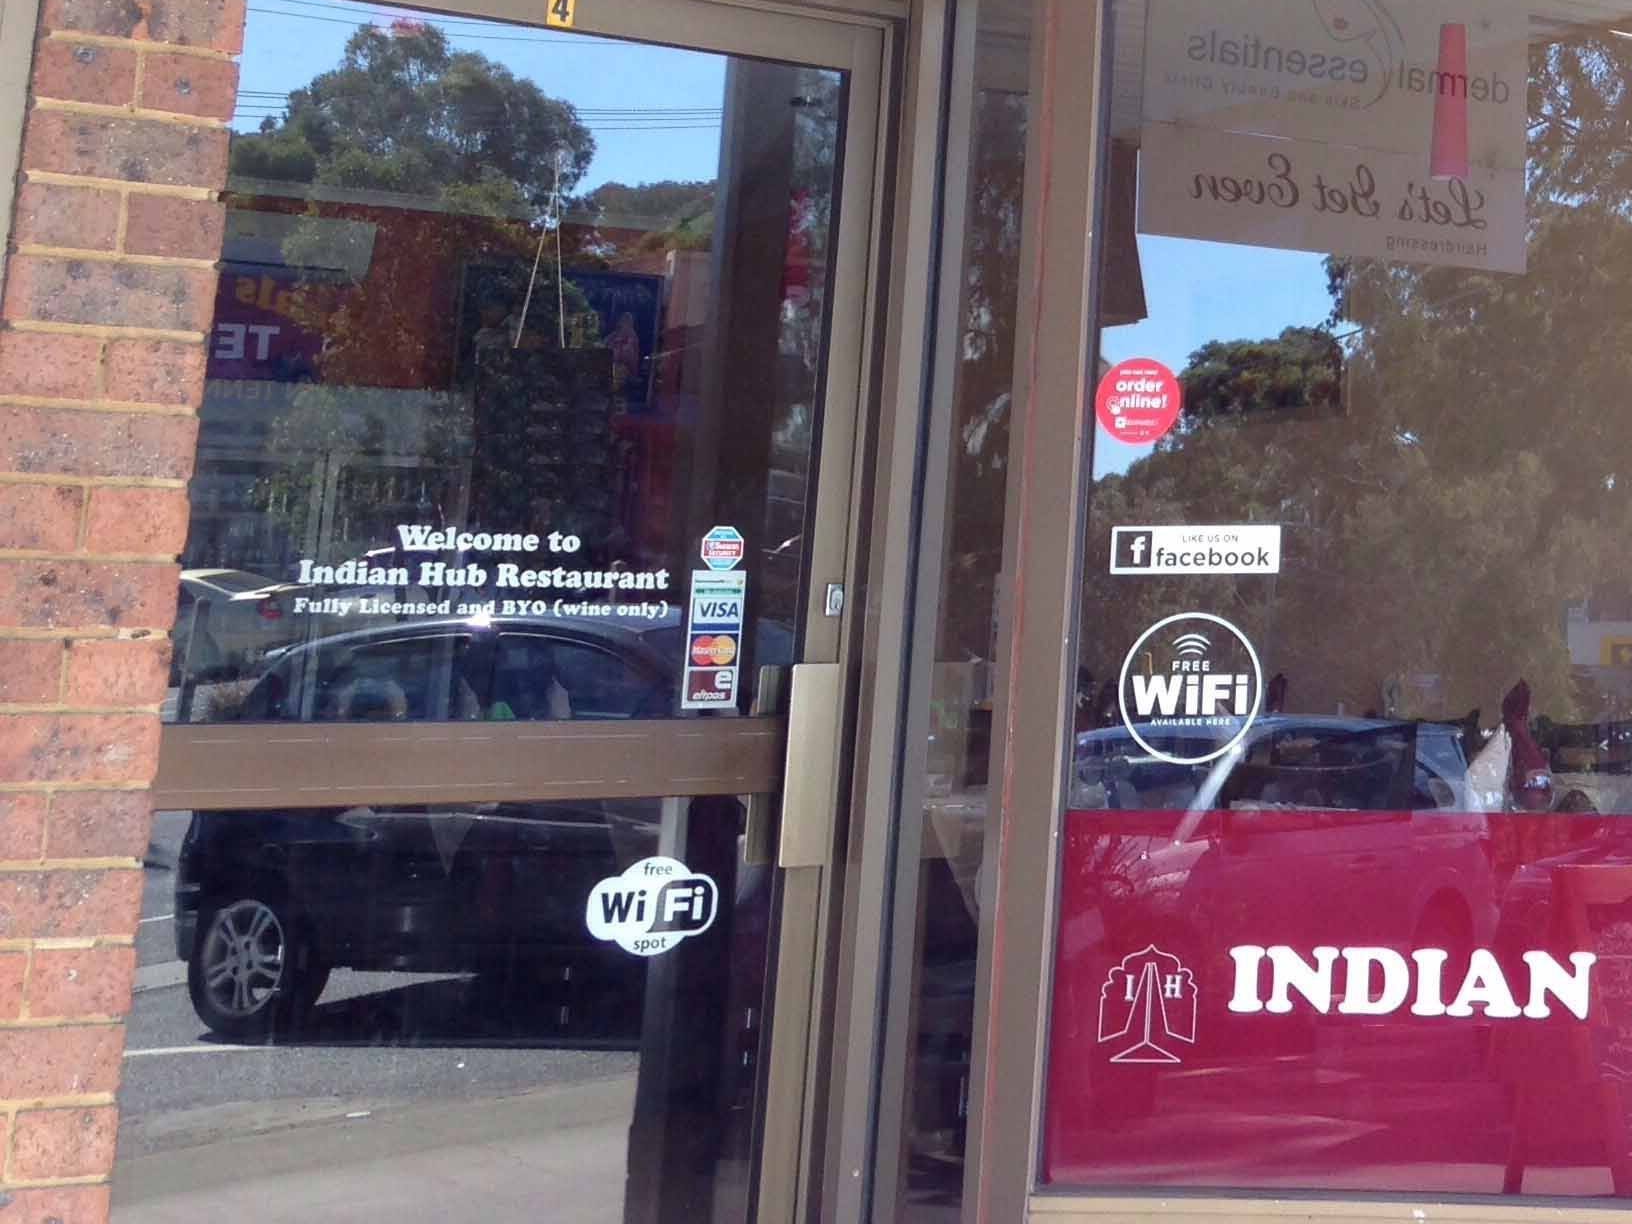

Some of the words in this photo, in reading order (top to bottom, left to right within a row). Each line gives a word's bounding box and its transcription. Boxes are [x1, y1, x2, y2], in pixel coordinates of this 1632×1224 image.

[1115, 377, 1163, 392] order
[397, 525, 540, 553] Welcome
[548, 531, 581, 553] to
[1182, 534, 1204, 543] LIKE
[1207, 534, 1220, 543] US
[1223, 534, 1239, 543] ON
[1156, 547, 1270, 567] facebook
[298, 559, 409, 585] Indian
[418, 562, 487, 587] Hub
[496, 563, 670, 589] Restaurant
[293, 597, 352, 616] Fully
[359, 598, 450, 614] Licensed
[456, 600, 495, 616] and
[502, 600, 547, 615] BYO
[553, 599, 611, 617] (wine
[617, 600, 669, 619] only)
[700, 602, 739, 618] VISA
[1172, 660, 1210, 672] FREE
[1132, 675, 1249, 716] WiFi
[1151, 718, 1203, 726] AVAILABLE
[1206, 718, 1230, 726] HERE
[644, 863, 673, 876] free
[633, 937, 666, 953] spot
[1228, 944, 1597, 1020] INDIAN
